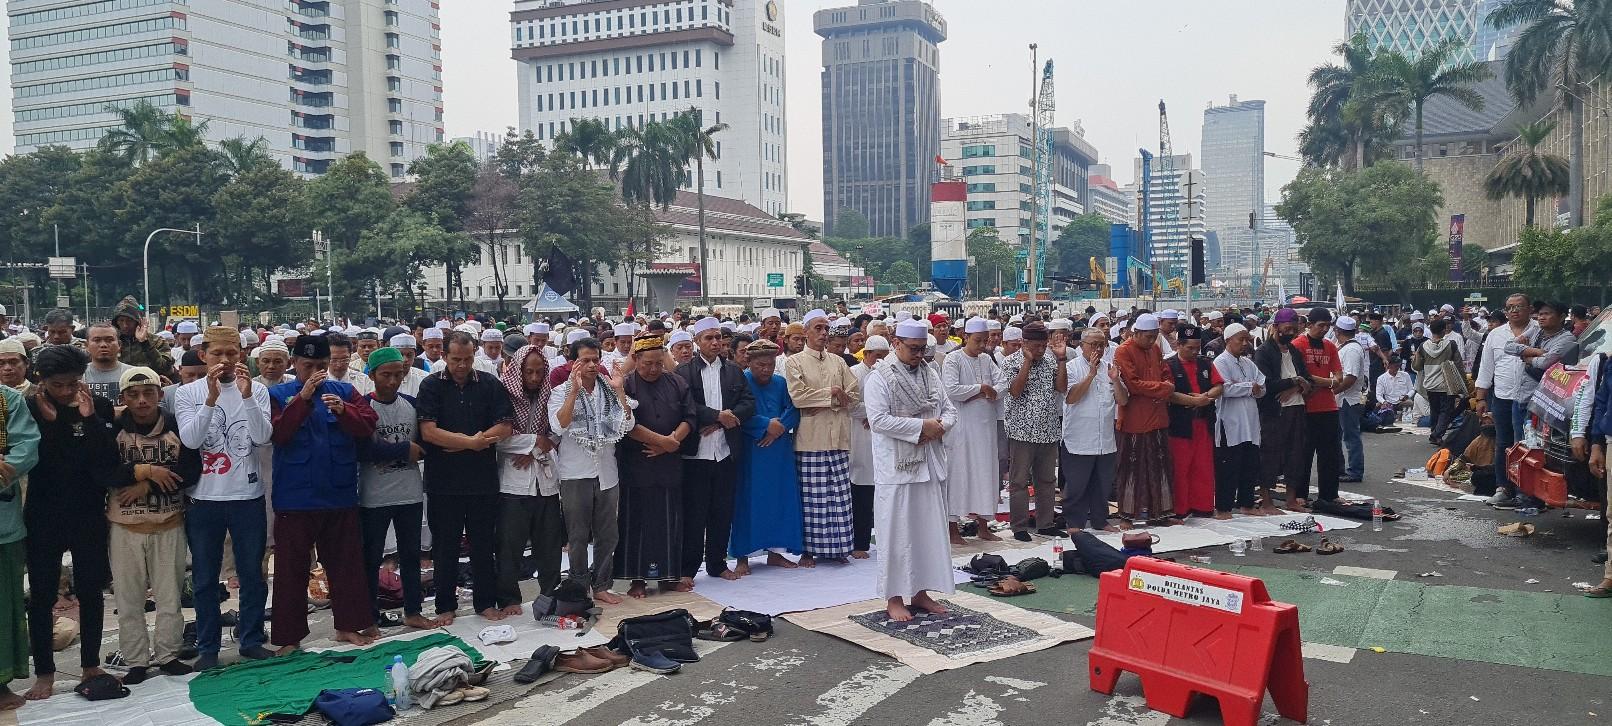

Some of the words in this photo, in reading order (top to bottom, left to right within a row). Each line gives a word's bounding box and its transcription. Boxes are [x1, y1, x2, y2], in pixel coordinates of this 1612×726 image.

[170, 305, 199, 316] ESDM
[1164, 580, 1204, 594] DITLANTAS
[1147, 584, 1170, 595] POLDA
[1173, 590, 1199, 600] METRO
[1201, 596, 1220, 606] JAYA
